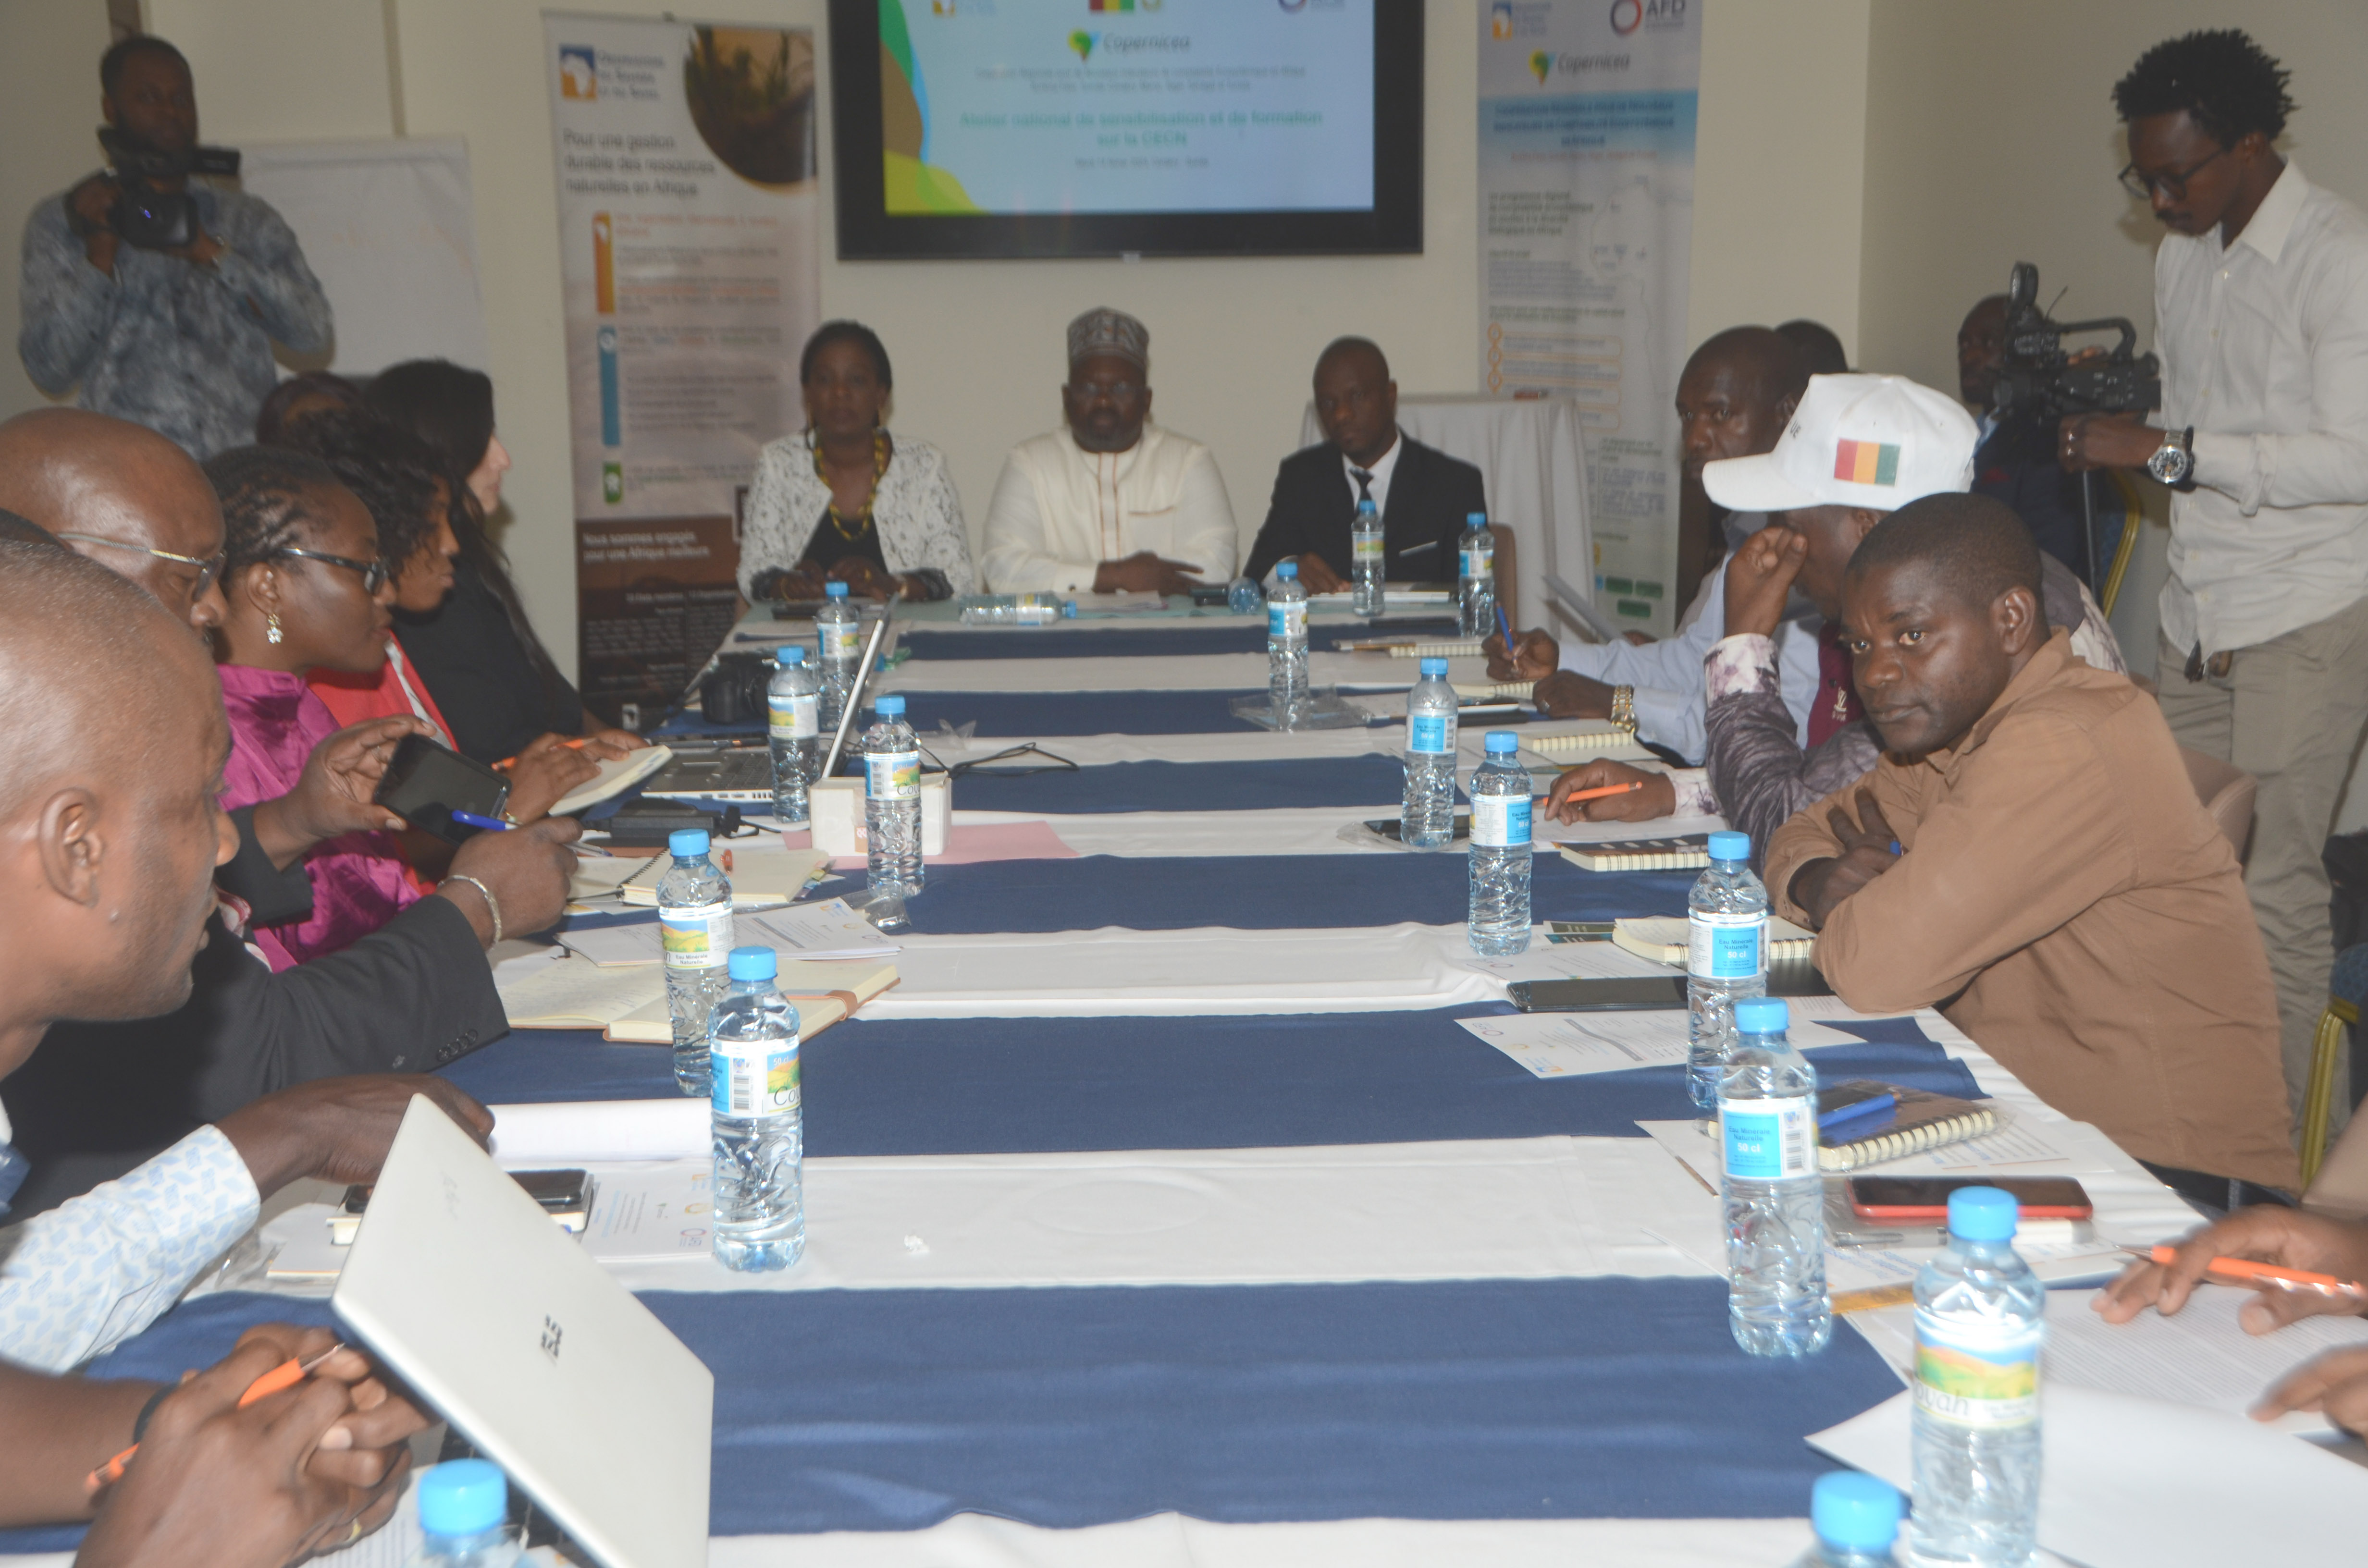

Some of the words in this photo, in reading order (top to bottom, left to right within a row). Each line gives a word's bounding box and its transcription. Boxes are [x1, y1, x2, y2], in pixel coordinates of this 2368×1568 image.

[773, 1056, 781, 1066] 50
[1738, 1142, 1748, 1152] 50
[1751, 1143, 1761, 1152] cl
